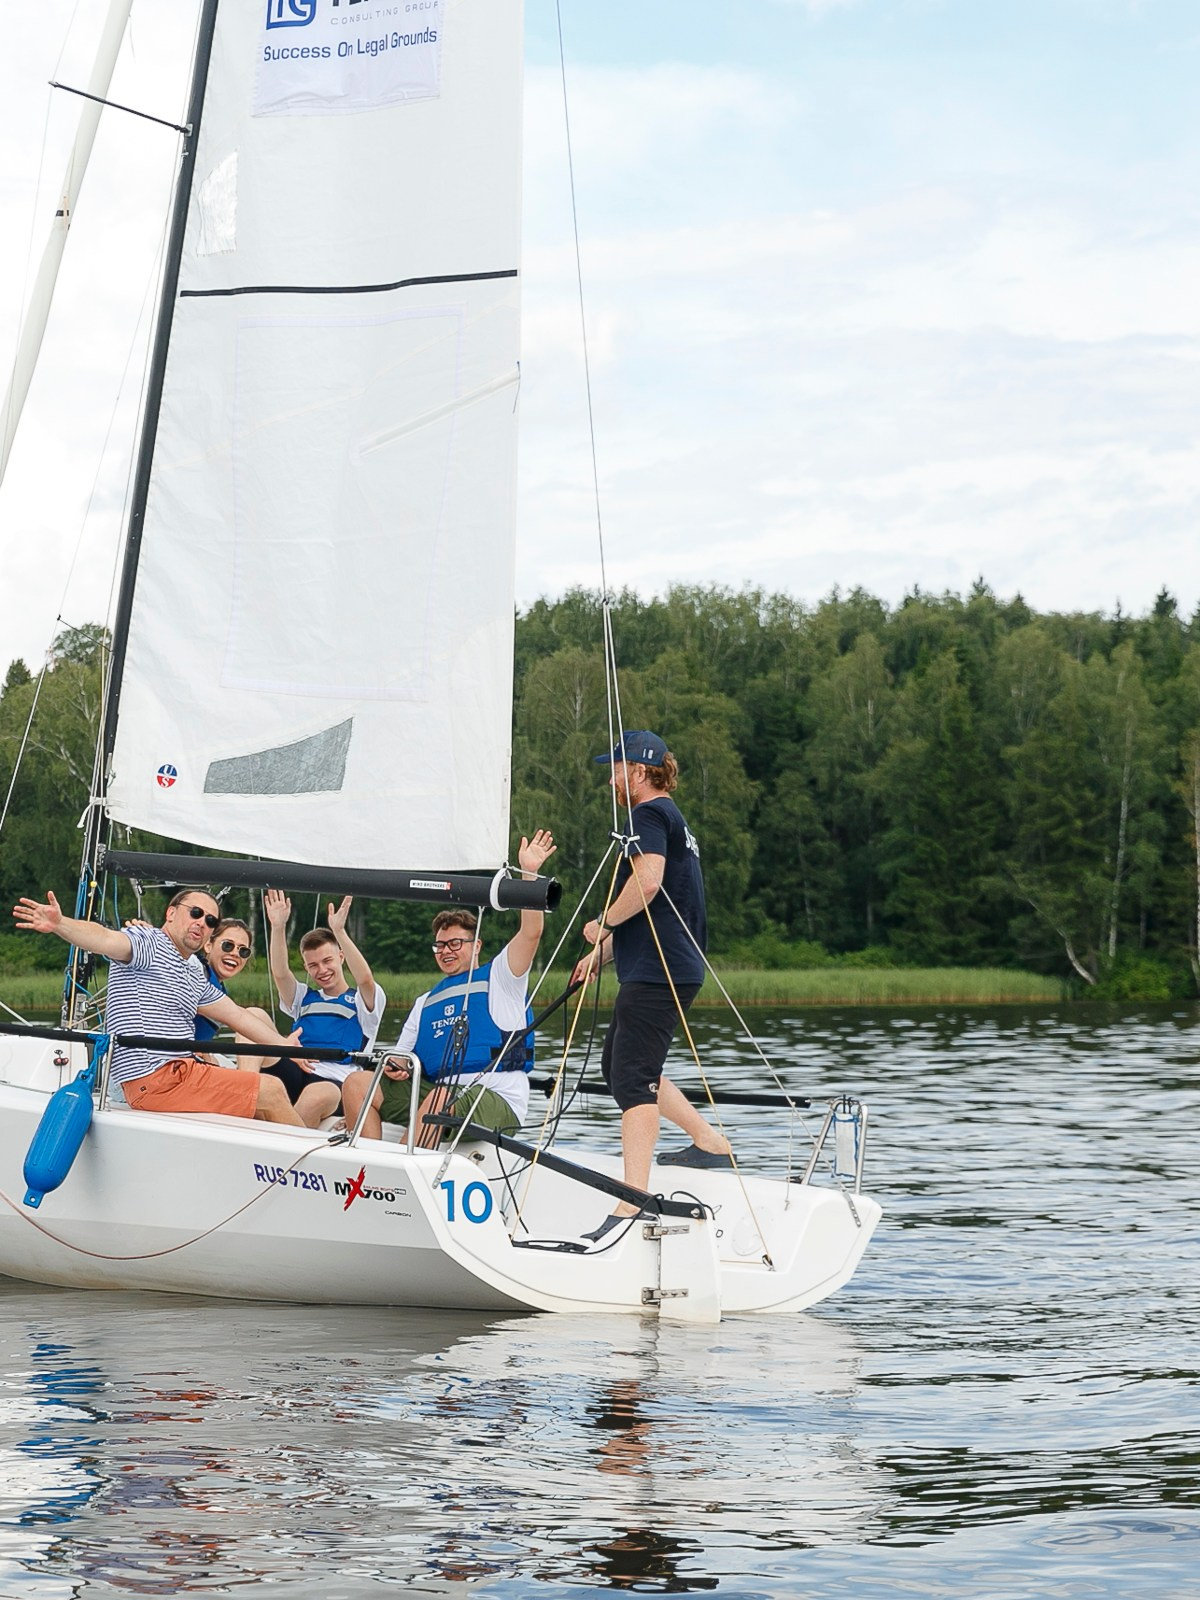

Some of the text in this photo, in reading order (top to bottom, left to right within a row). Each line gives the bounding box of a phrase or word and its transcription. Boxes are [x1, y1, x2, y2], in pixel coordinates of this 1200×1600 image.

[330, 7, 399, 25] CONSULTING
[264, 27, 437, 61] Success On Legal Grounds
[253, 1163, 328, 1193] RUS 7281
[333, 1165, 396, 1211] MX700
[440, 1180, 493, 1224] 10
